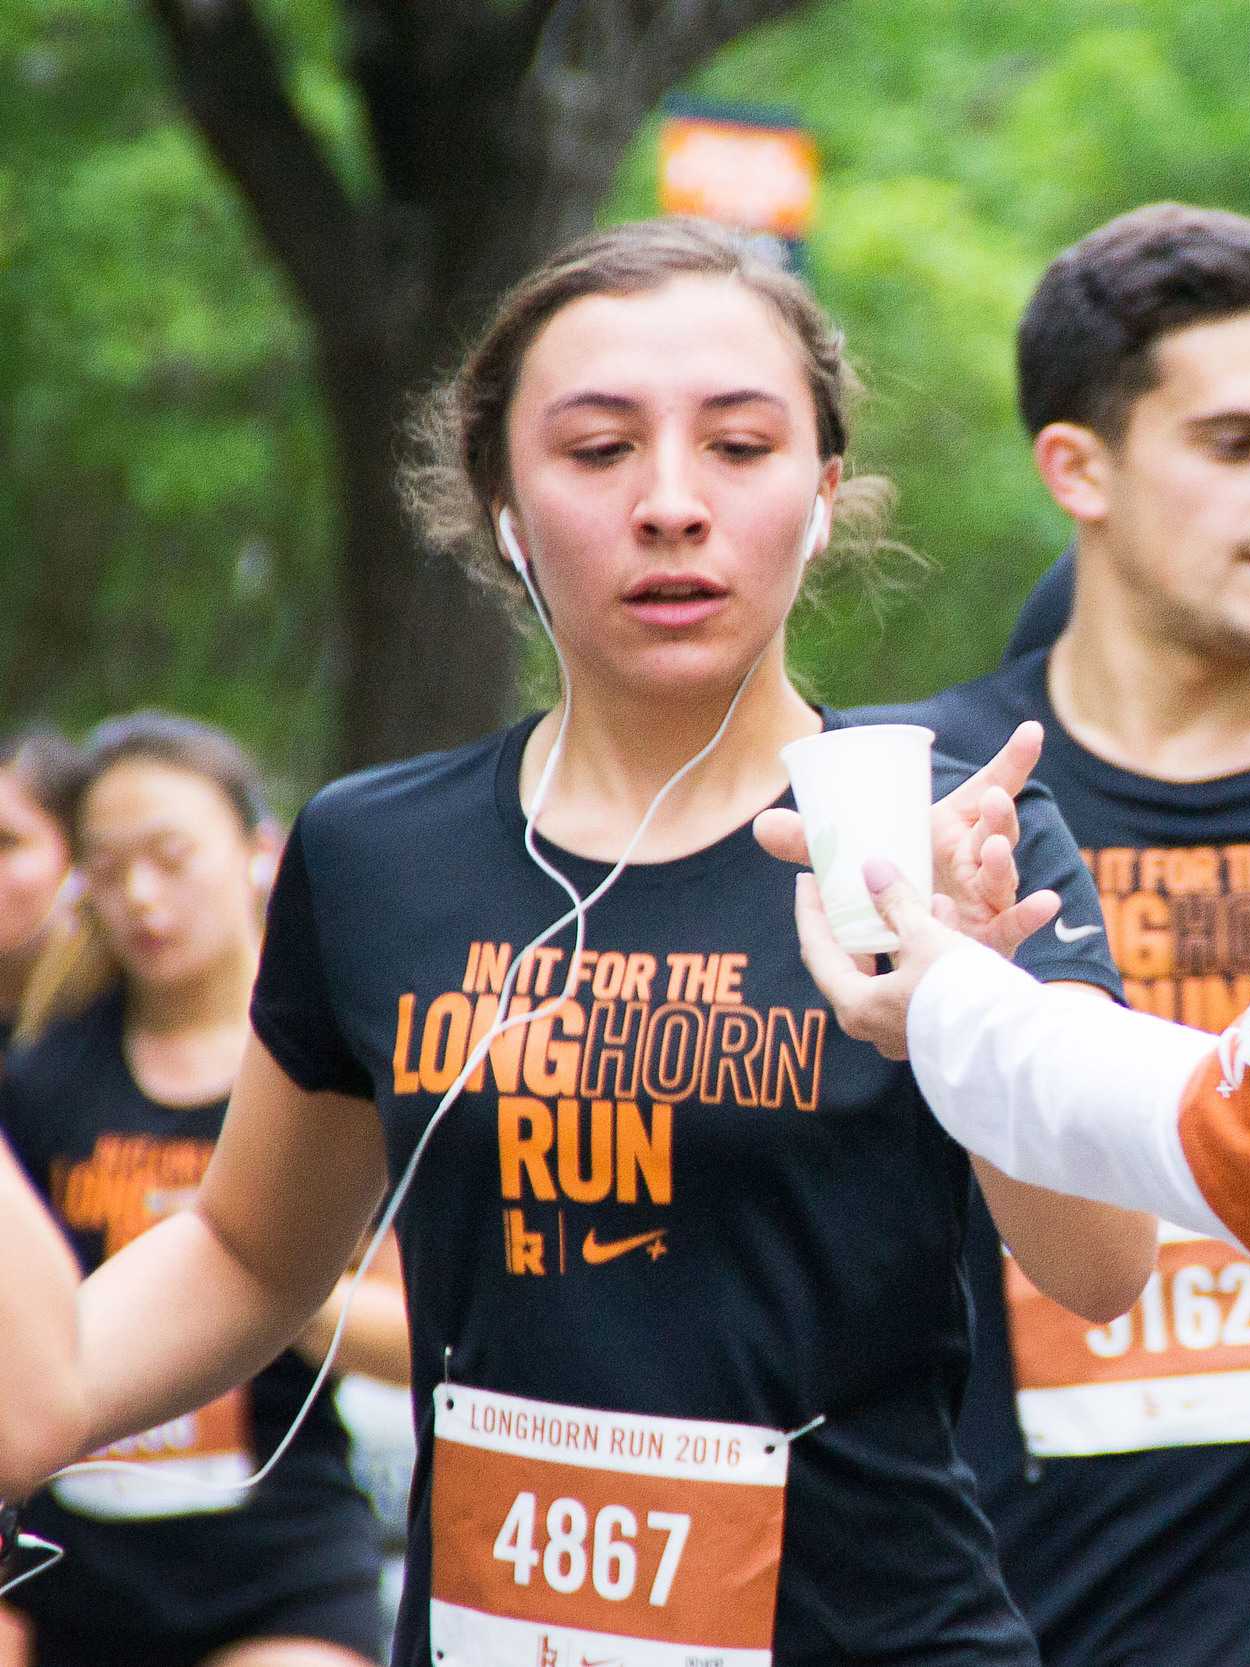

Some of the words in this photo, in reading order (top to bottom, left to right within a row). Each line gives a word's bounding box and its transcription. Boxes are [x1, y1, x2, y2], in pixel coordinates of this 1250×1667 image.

[1140, 846, 1219, 894] FOR
[462, 940, 512, 993] IN
[515, 946, 563, 996] IT
[564, 950, 658, 1001] FOR
[666, 952, 748, 1003] THE
[393, 992, 828, 1111] LONGHORN
[499, 1096, 673, 1205] RUN
[469, 1402, 599, 1452] LONGHORN
[609, 1430, 665, 1460] RUN
[674, 1435, 743, 1467] 2016
[493, 1491, 692, 1608] 4867
